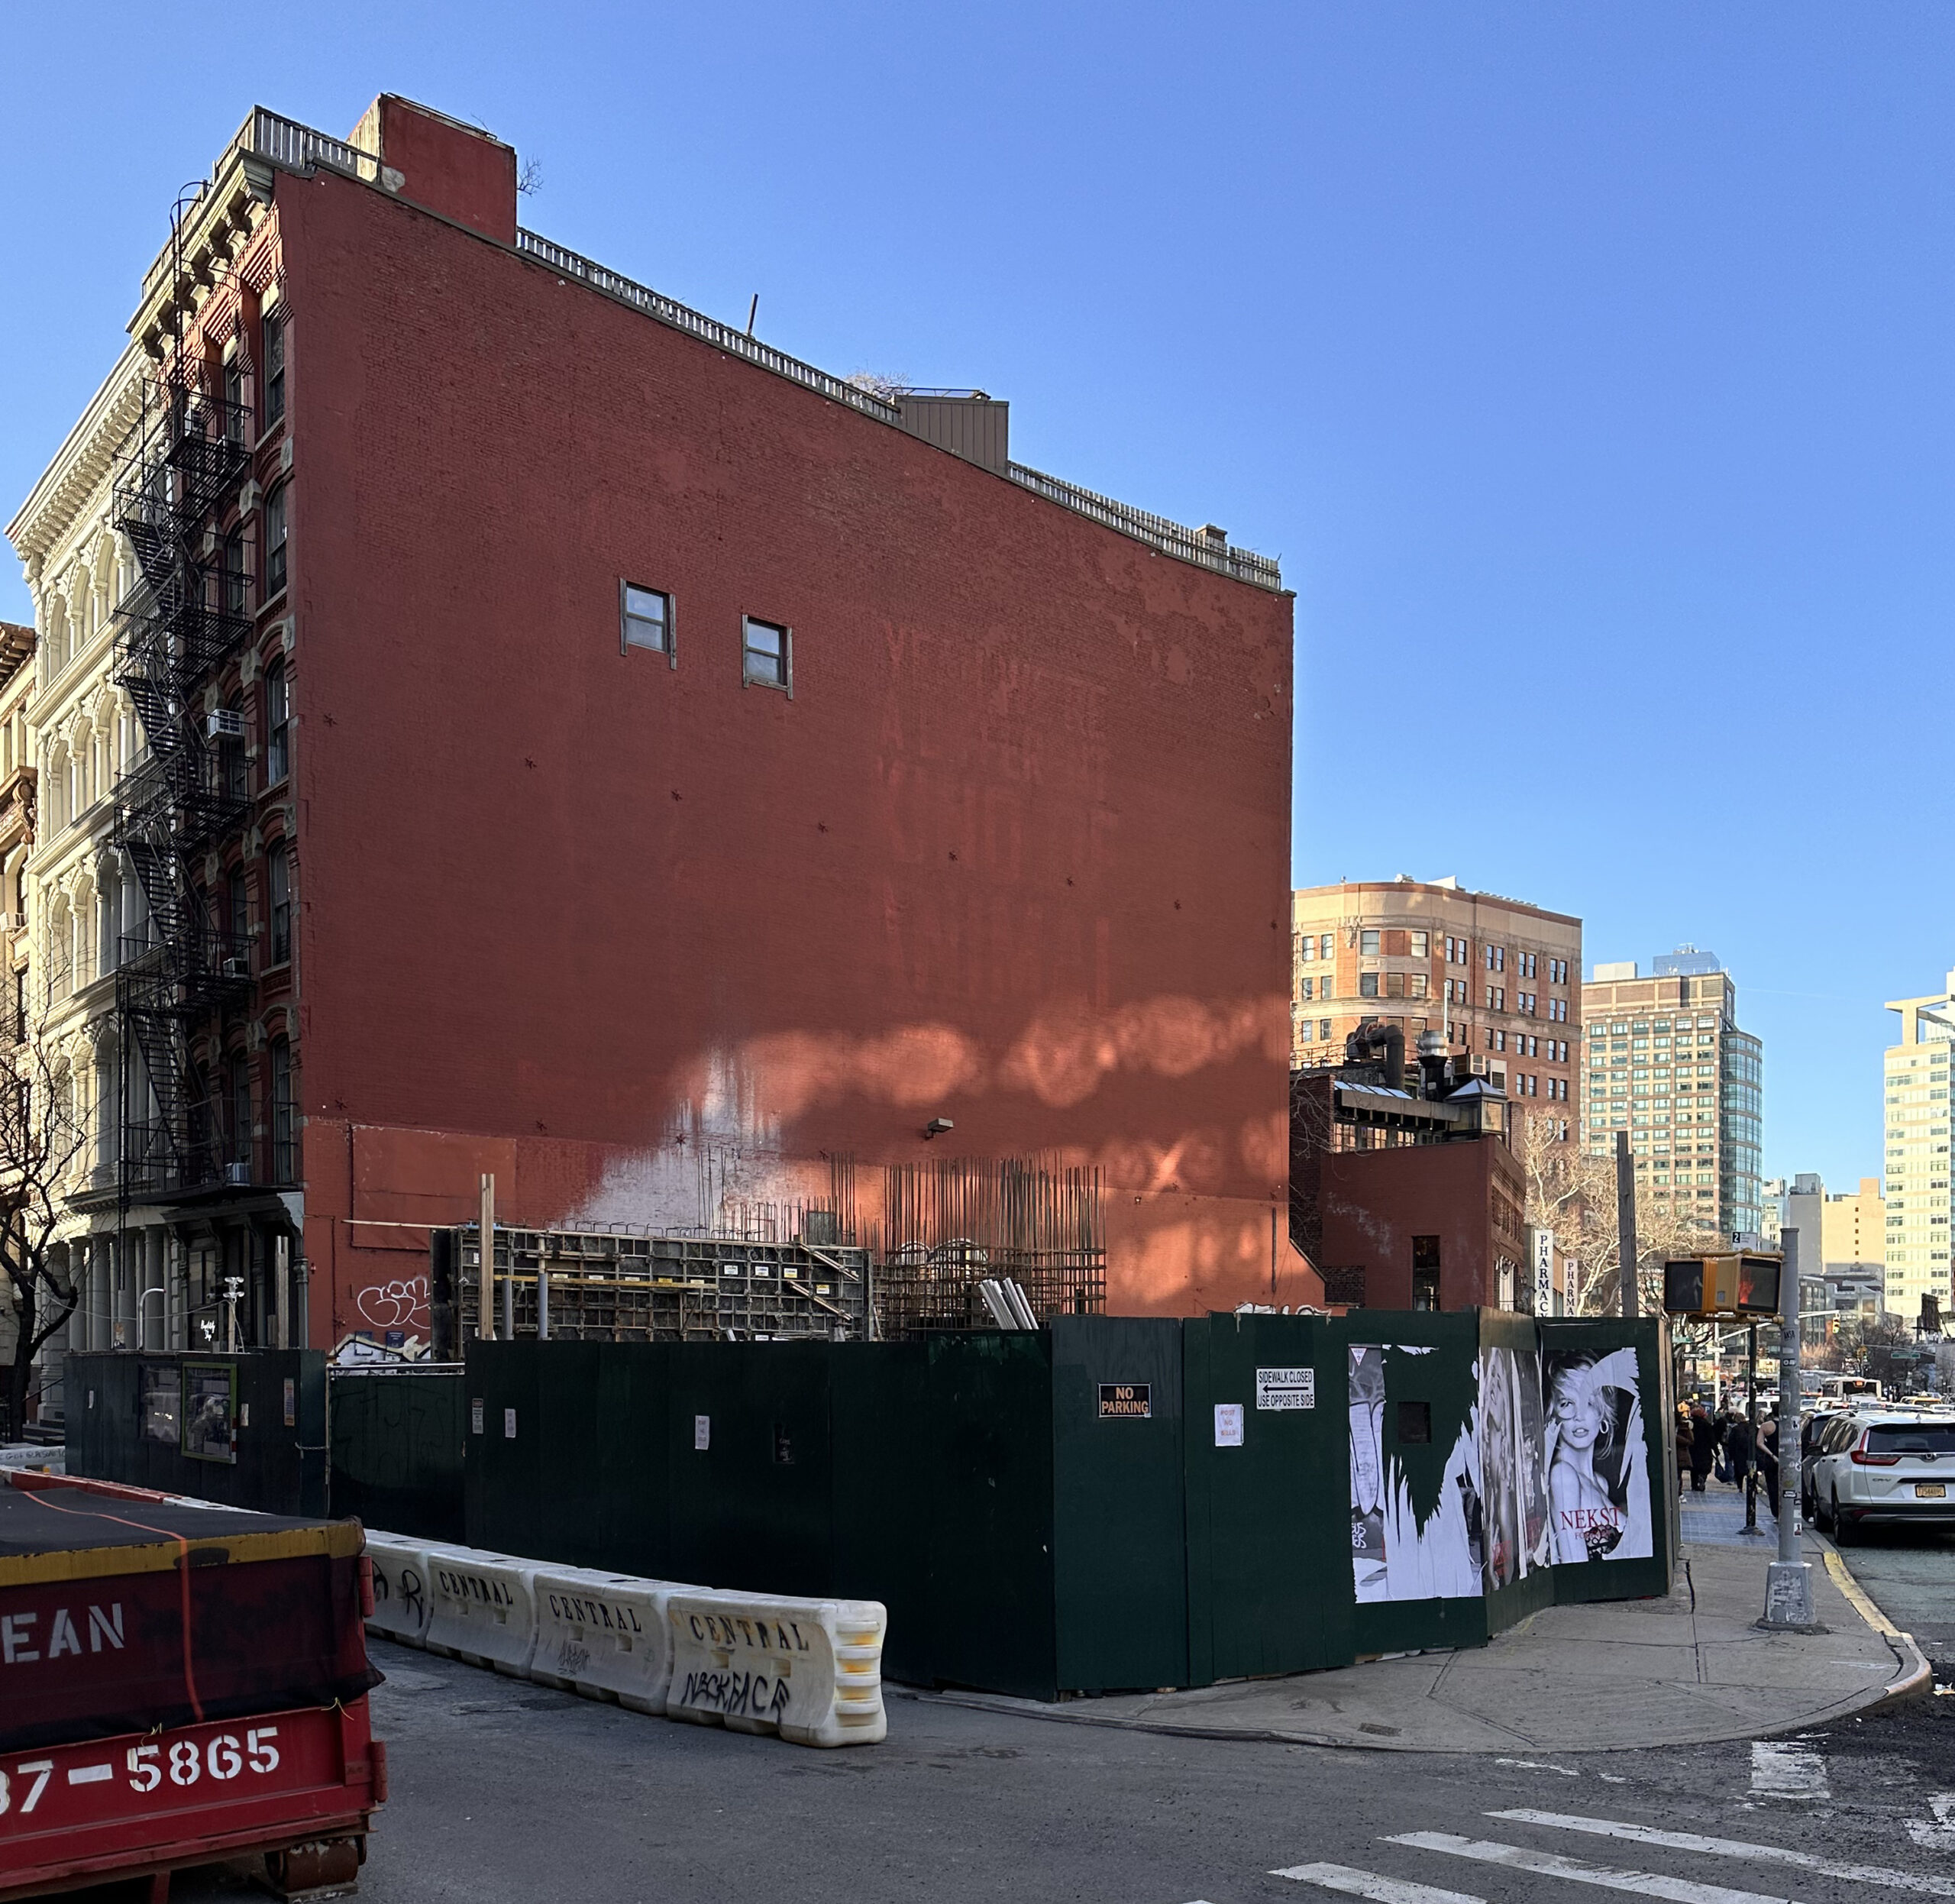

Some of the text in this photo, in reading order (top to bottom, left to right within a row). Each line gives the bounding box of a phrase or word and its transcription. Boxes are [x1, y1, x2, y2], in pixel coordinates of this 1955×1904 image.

[1566, 1262, 1575, 1317] PHARMA
[1259, 1371, 1312, 1383] SIDEWALK CLOSED
[1116, 1387, 1134, 1399] NO
[1258, 1395, 1314, 1407] USE OPPOSITE SIDE
[1101, 1401, 1149, 1414] PARKING
[1559, 1507, 1622, 1531] NEKST
[439, 1569, 515, 1605] CENTRAL
[549, 1594, 642, 1633] CENTRAL
[690, 1615, 809, 1651] CENTRAL
